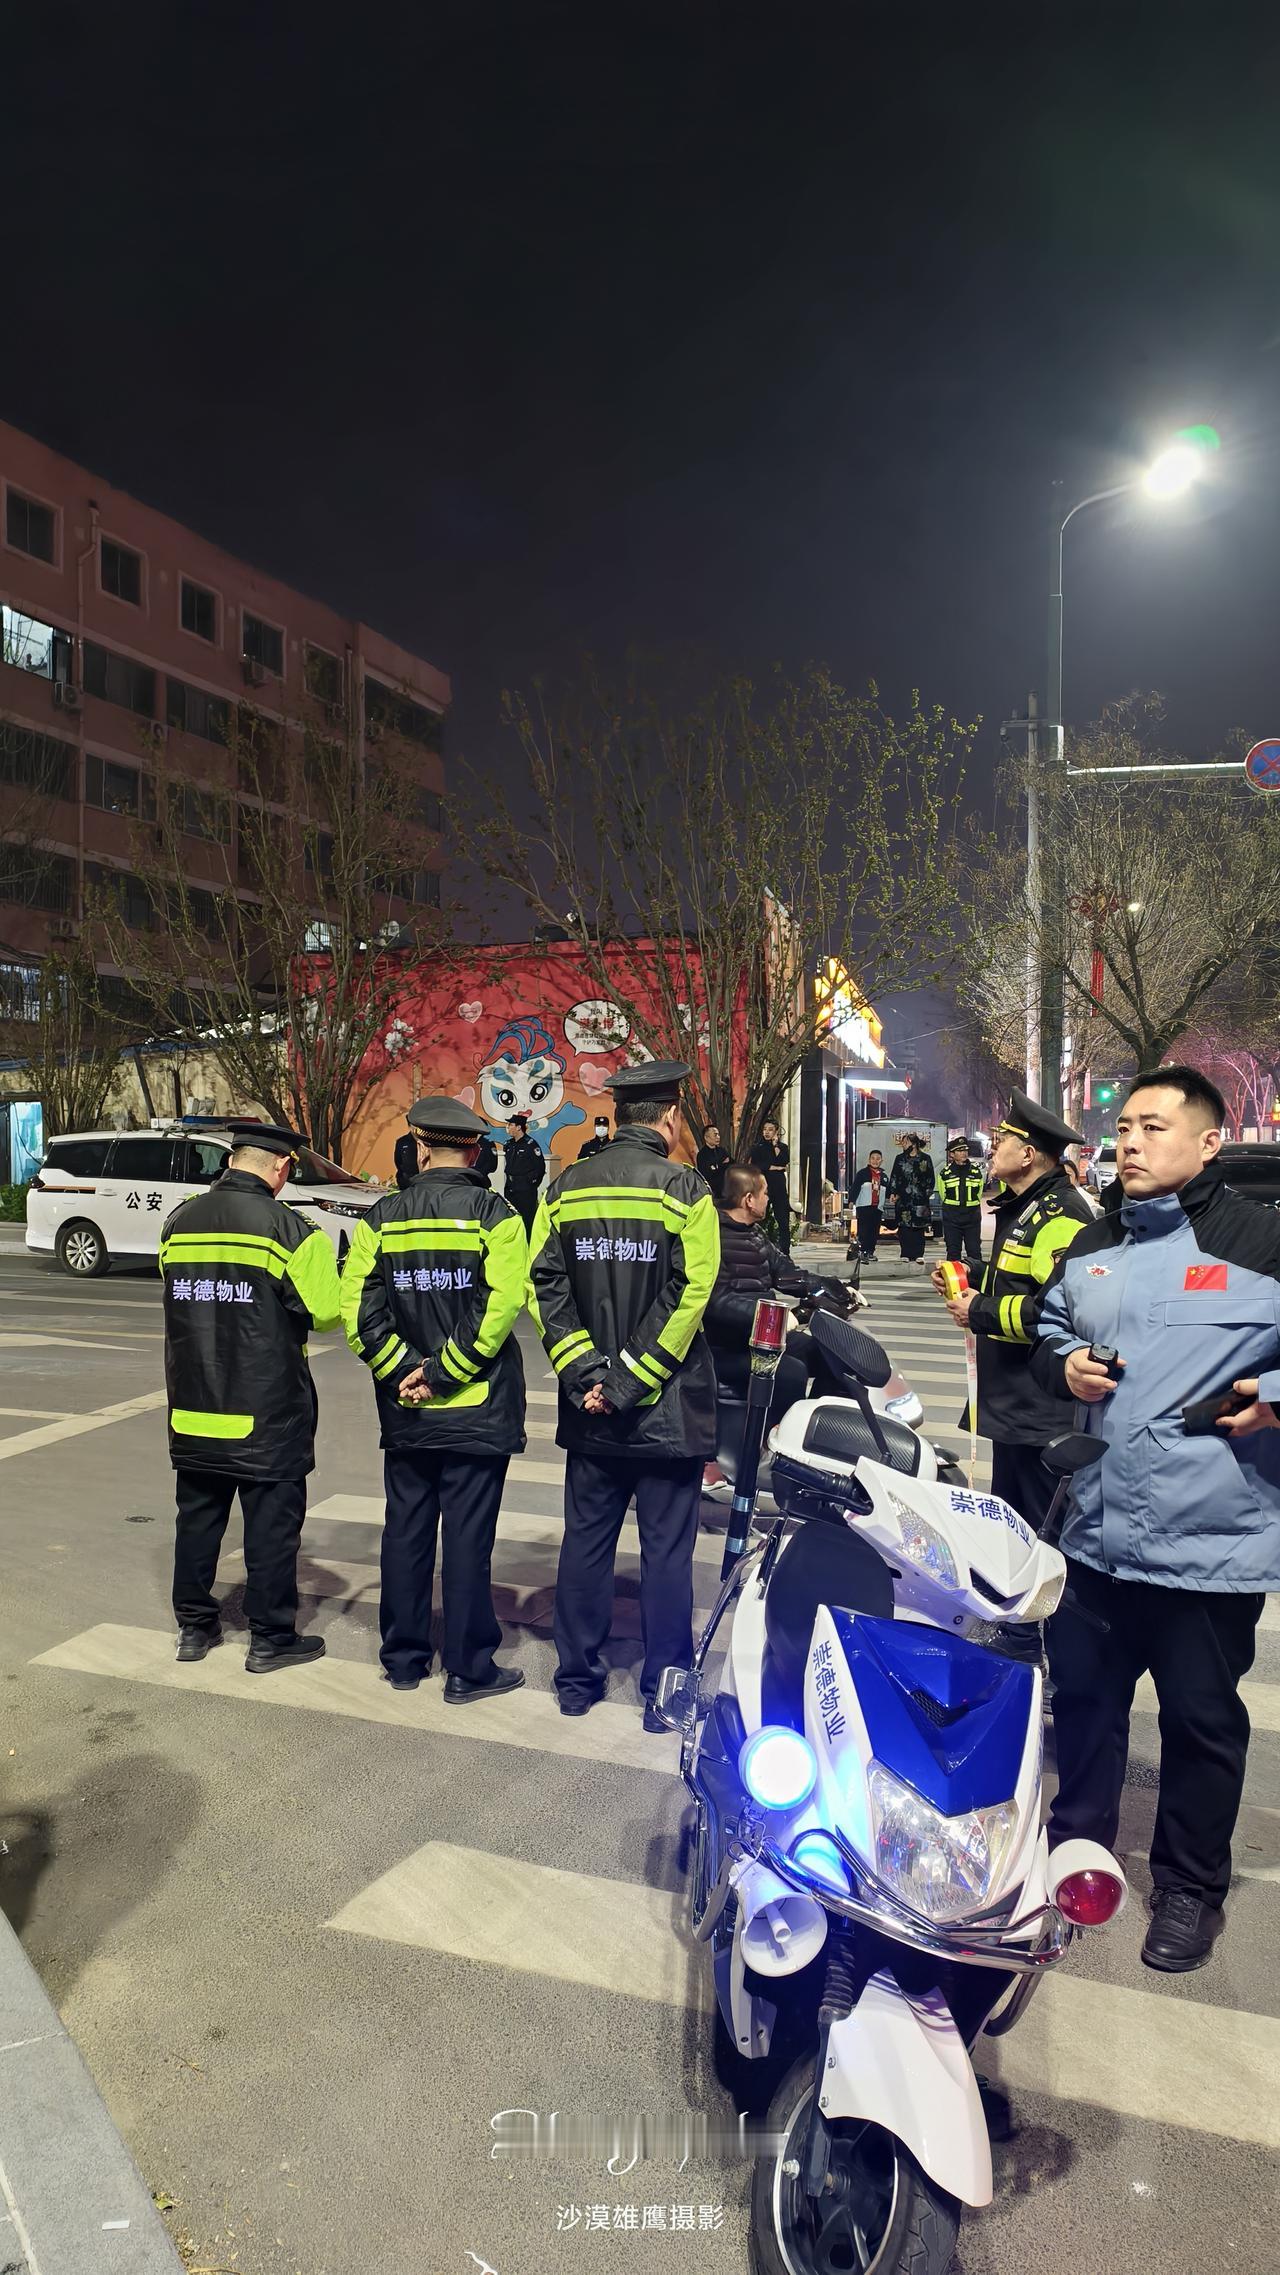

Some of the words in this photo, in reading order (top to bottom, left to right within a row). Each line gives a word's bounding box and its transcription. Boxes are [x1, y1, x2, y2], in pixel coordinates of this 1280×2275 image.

[125, 1191, 162, 1211] 公安
[172, 1278, 254, 1303] 崇德物业
[393, 1267, 473, 1291] 崇德物业
[951, 1490, 1032, 1549] 崇德物业
[813, 1640, 847, 1745] 崇德物业
